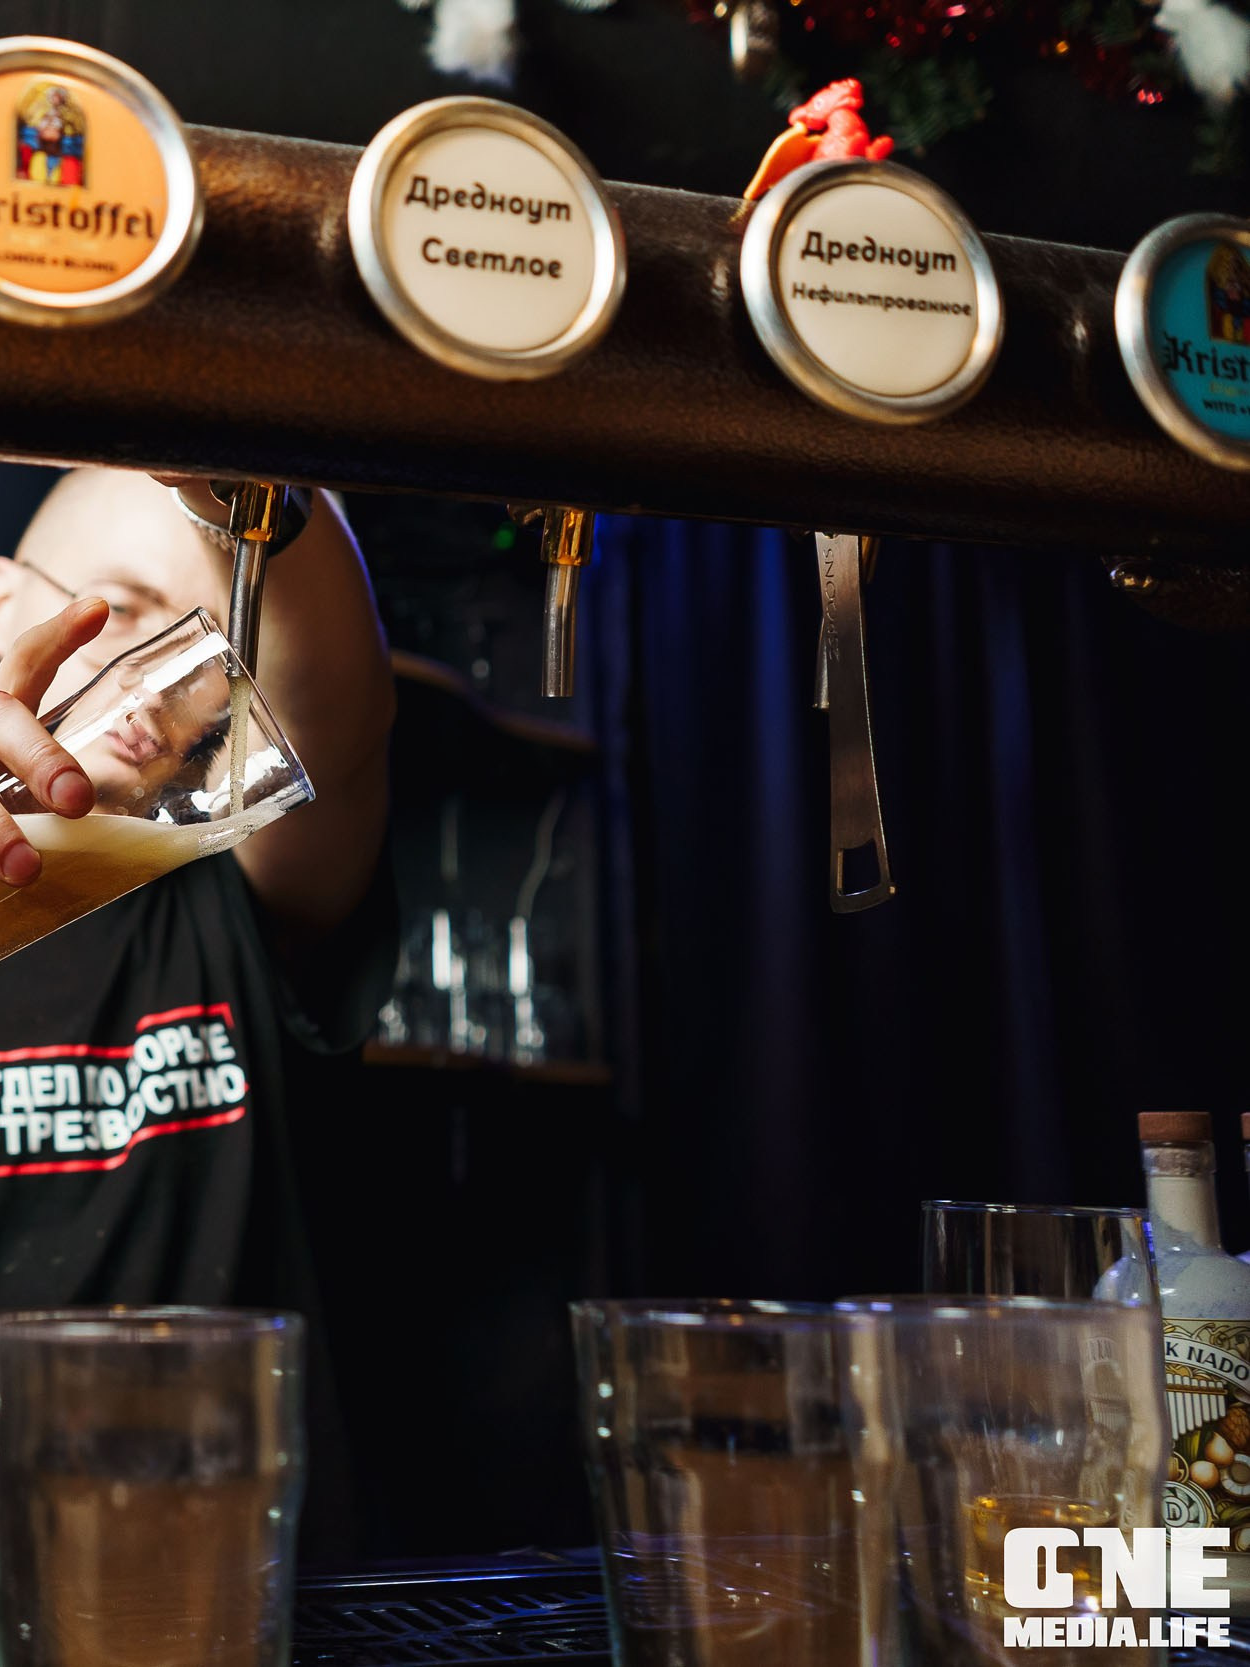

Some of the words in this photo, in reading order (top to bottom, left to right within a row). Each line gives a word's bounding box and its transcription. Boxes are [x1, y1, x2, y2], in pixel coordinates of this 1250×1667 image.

[404, 175, 572, 226] Дредноут
[421, 237, 564, 280] Светлое
[800, 231, 957, 276] Дредноут
[791, 282, 973, 317] Нефильтрованное
[126, 1022, 237, 1091] ОРЬЕ
